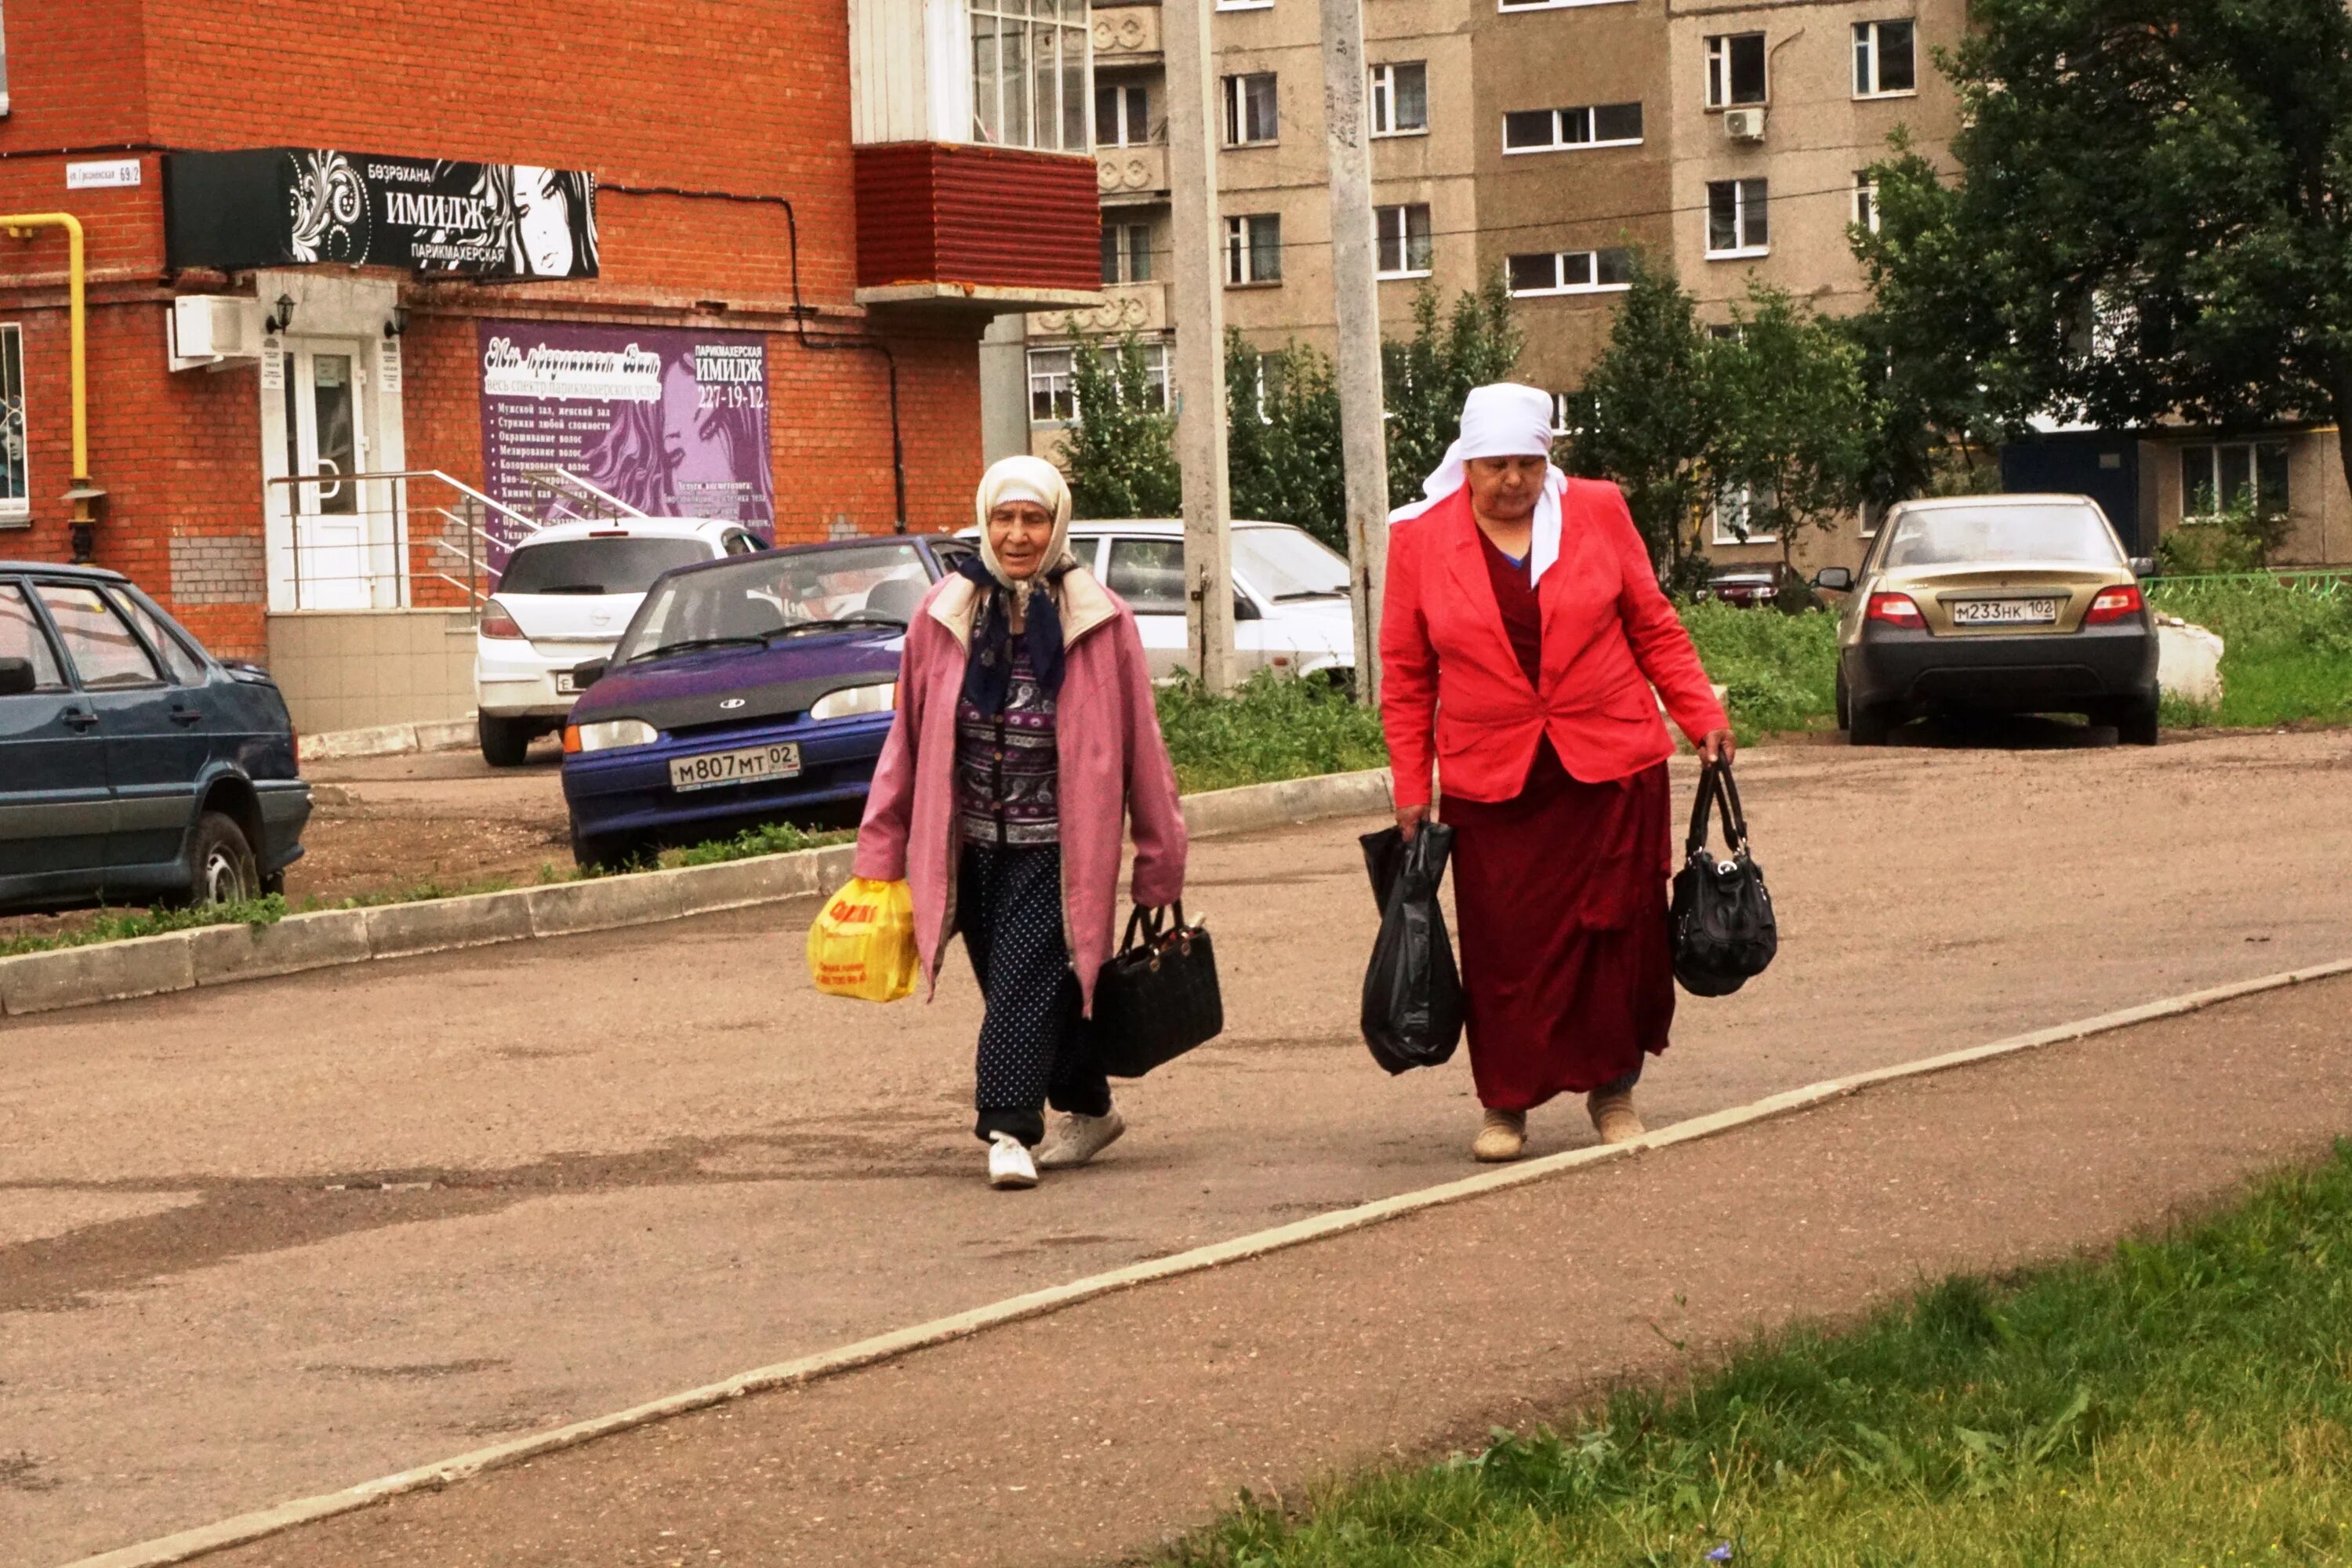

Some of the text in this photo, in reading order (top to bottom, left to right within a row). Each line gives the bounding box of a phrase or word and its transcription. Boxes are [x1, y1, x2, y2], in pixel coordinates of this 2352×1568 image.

[386, 191, 488, 235] ИМИДЖ
[412, 242, 506, 263] ПАРИКМАХЕРСКАЯ
[487, 339, 659, 380] Мы предлагаем Вам
[695, 345, 762, 358] ПАРИКМАХЕРСКАЯ
[695, 358, 763, 386] ИМИДЖ
[487, 379, 509, 391] весь
[512, 380, 546, 395] спектр
[698, 385, 764, 408] 227-19-12
[498, 402, 610, 417] Мужской зал, женский зал
[498, 416, 611, 430] Стрижки любой сложности
[499, 430, 582, 444] Окрашивание волос
[499, 445, 581, 458] Мелирование волос
[568, 463, 590, 471] волос
[679, 746, 792, 782] М807МТ 02
